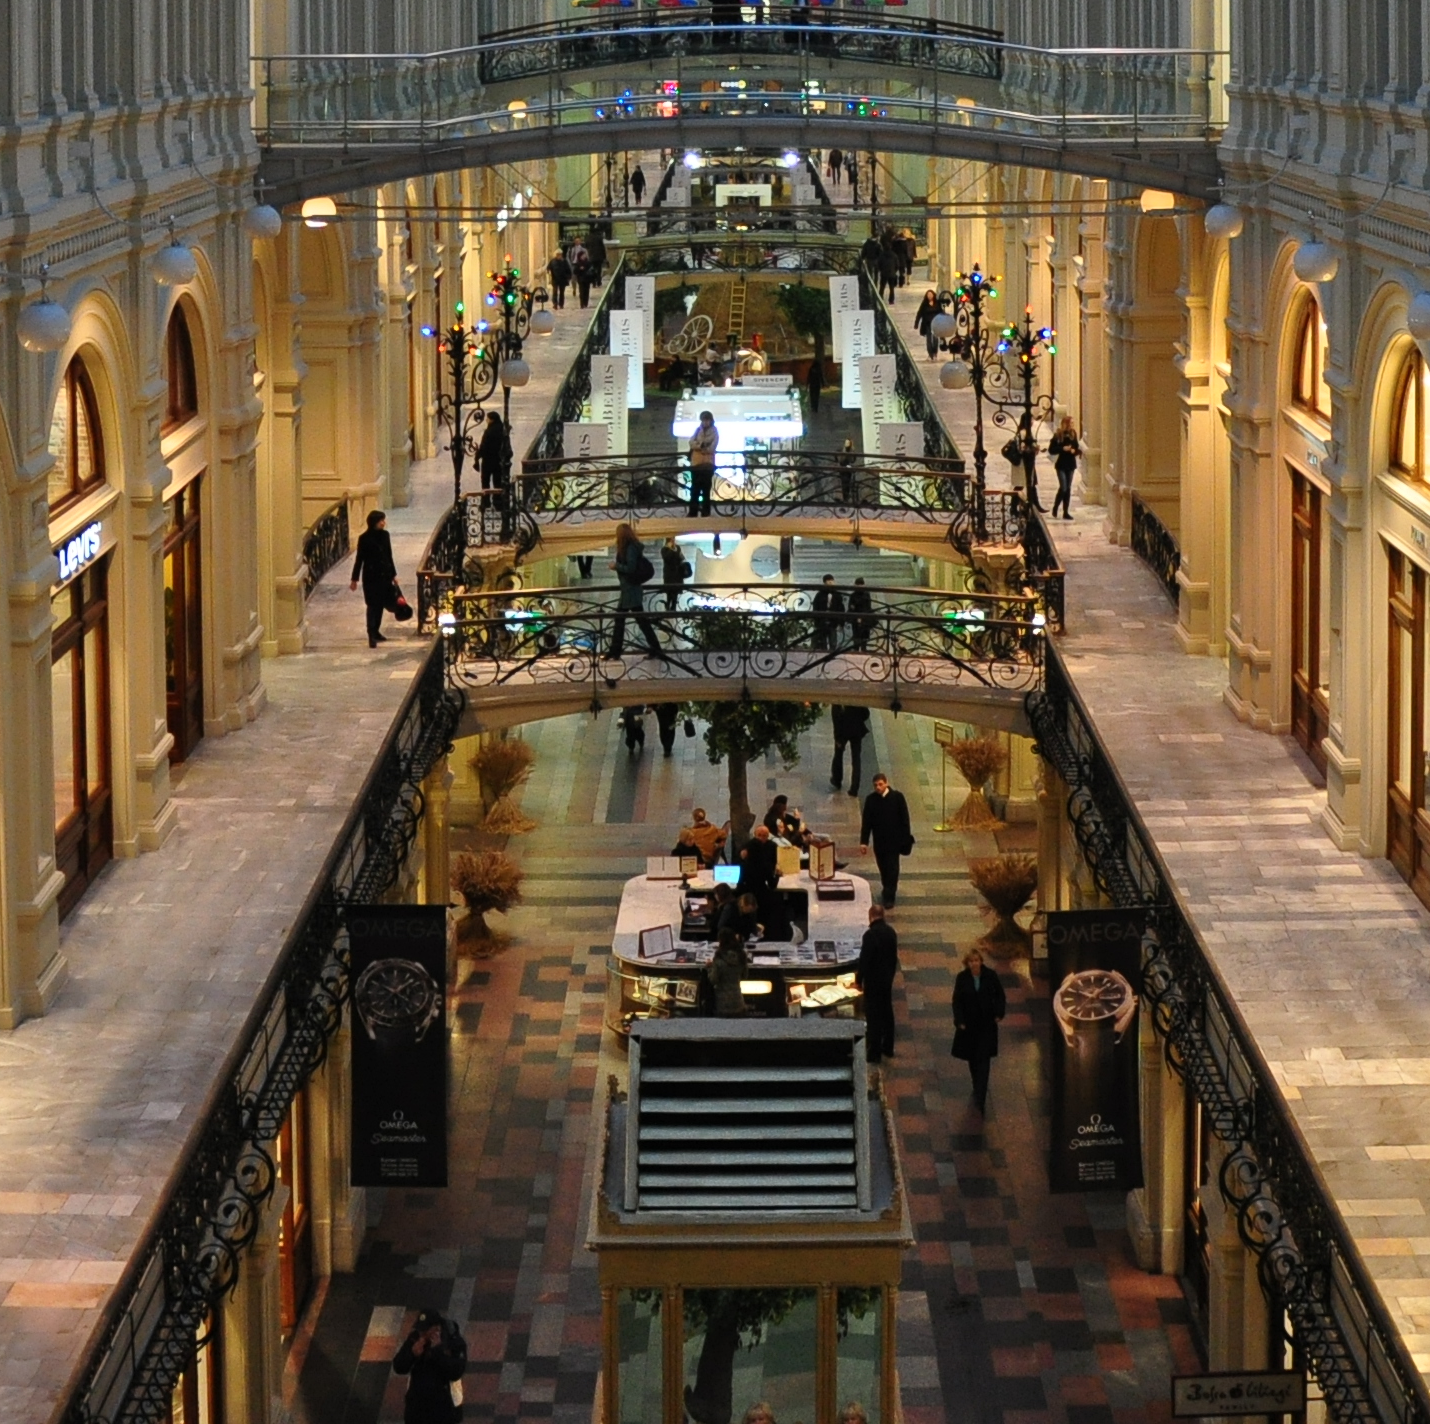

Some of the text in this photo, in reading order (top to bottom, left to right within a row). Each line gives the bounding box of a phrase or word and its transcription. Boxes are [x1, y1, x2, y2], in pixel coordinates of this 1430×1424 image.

[602, 364, 614, 420] BEERS
[872, 364, 884, 420] BEERS
[351, 918, 444, 939] OMEGA
[1049, 921, 1140, 945] OMEGA
[379, 1120, 418, 1129] OMEGA
[1077, 1124, 1116, 1135] OMEGA
